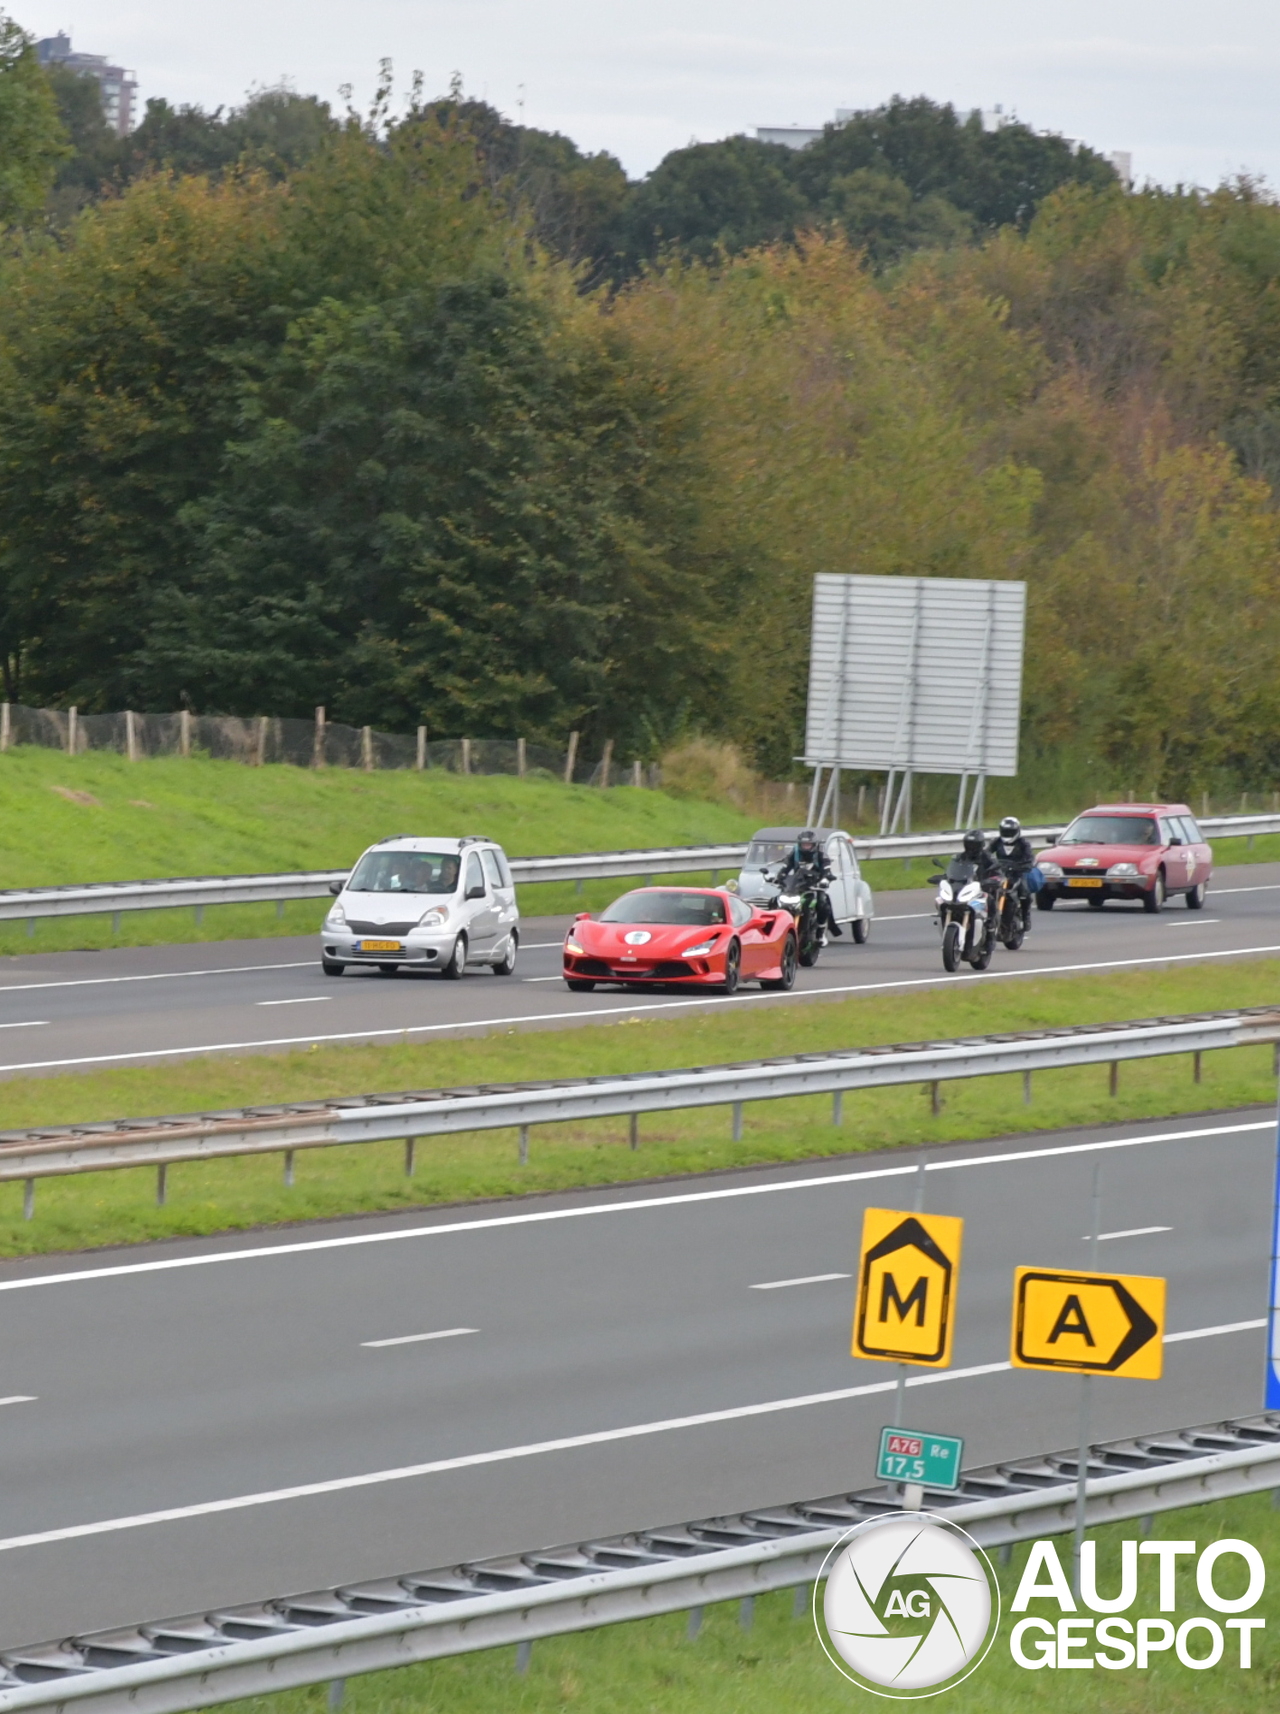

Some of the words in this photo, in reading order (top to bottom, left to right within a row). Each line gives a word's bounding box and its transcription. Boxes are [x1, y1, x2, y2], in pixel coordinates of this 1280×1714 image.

[878, 1271, 929, 1328] M
[1045, 1294, 1097, 1348] A
[885, 1456, 925, 1478] 17,5
[889, 1438, 920, 1455] A76
[930, 1444, 950, 1459] Re
